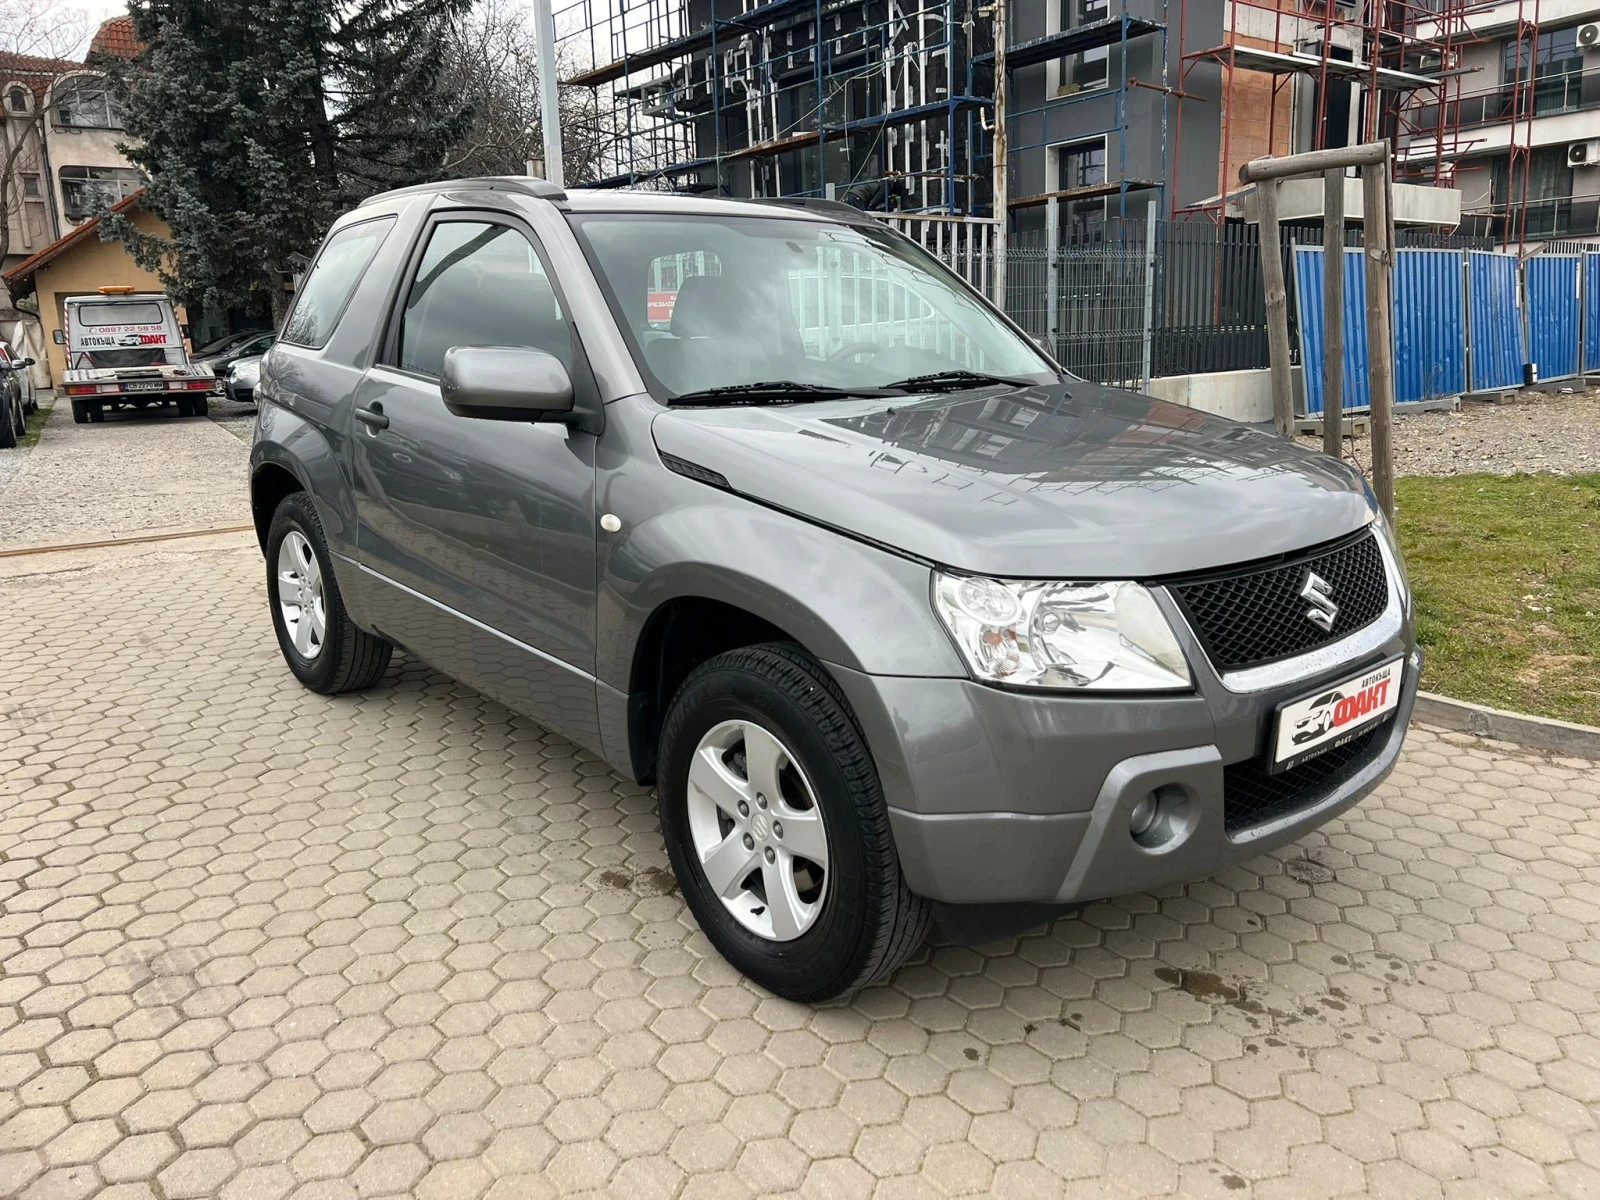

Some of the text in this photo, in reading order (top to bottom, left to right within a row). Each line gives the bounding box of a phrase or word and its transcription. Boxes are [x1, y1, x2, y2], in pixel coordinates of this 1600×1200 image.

[80, 336, 115, 346] АВТОКЪЩА
[1361, 668, 1391, 689] АВТОКЪЩА
[1333, 678, 1391, 727] ФАКТ
